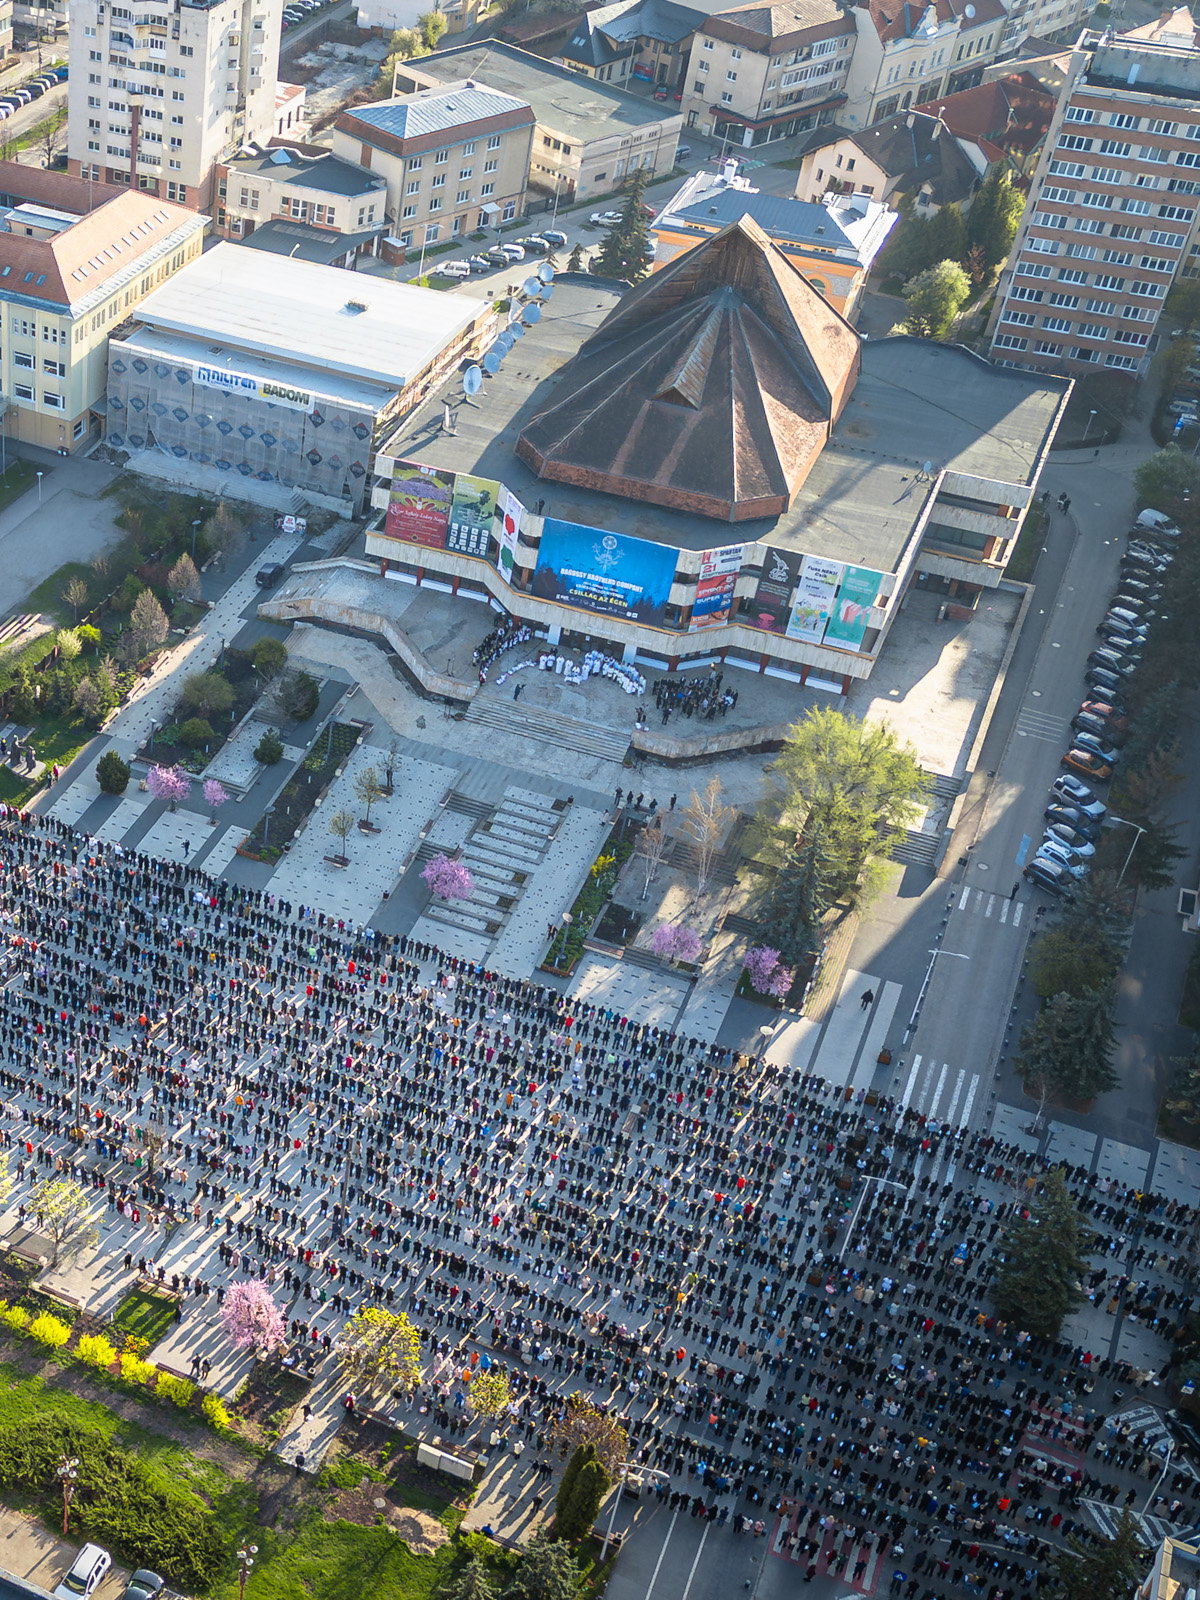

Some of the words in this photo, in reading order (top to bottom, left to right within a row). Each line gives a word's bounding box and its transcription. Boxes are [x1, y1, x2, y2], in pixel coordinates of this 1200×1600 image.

[263, 383, 310, 405] BADOMI
[703, 564, 717, 574] 21
[616, 579, 643, 592] COMPANY
[569, 588, 598, 600] CSILLAG
[609, 597, 628, 608] ÉGEN
[697, 594, 720, 604] SUPER
